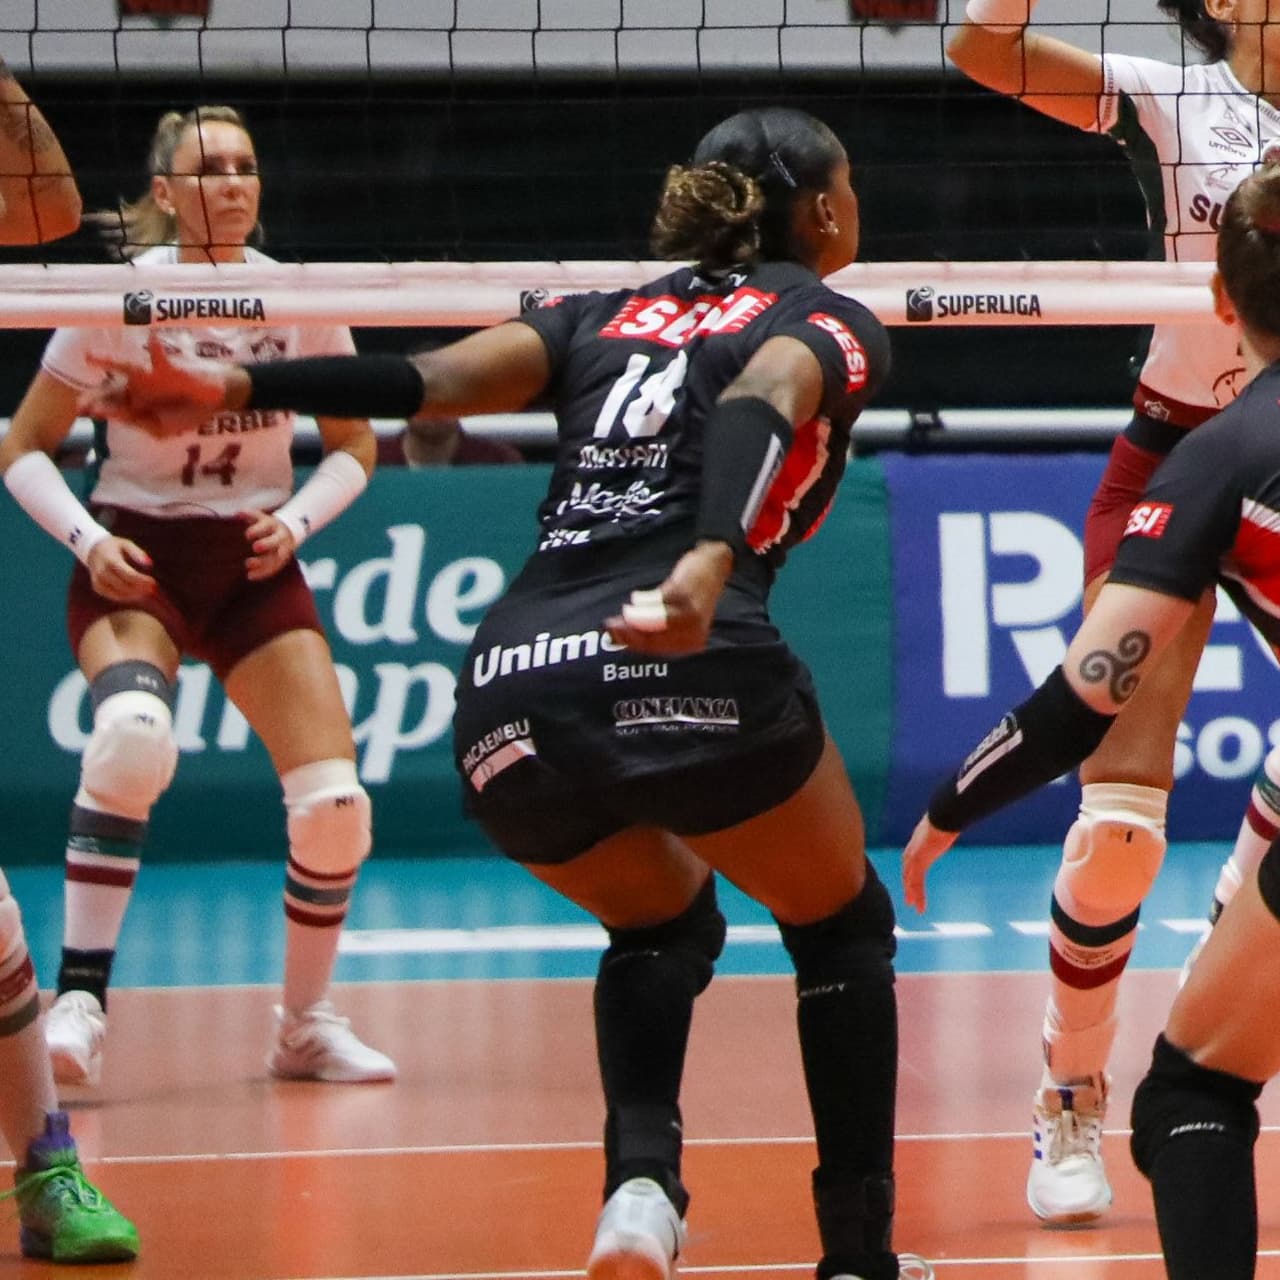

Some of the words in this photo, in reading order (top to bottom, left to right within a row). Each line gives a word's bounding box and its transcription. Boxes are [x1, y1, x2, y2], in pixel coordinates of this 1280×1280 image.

[156, 297, 266, 322] SUPERLIGA
[937, 293, 1041, 319] SUPERLIGA
[814, 317, 866, 384] SESI
[181, 443, 242, 487] 14
[1123, 505, 1163, 537] SI
[298, 523, 505, 647] rde
[473, 629, 629, 688] Unim
[603, 661, 668, 682] Bauru
[462, 717, 531, 775] PACAEMBU
